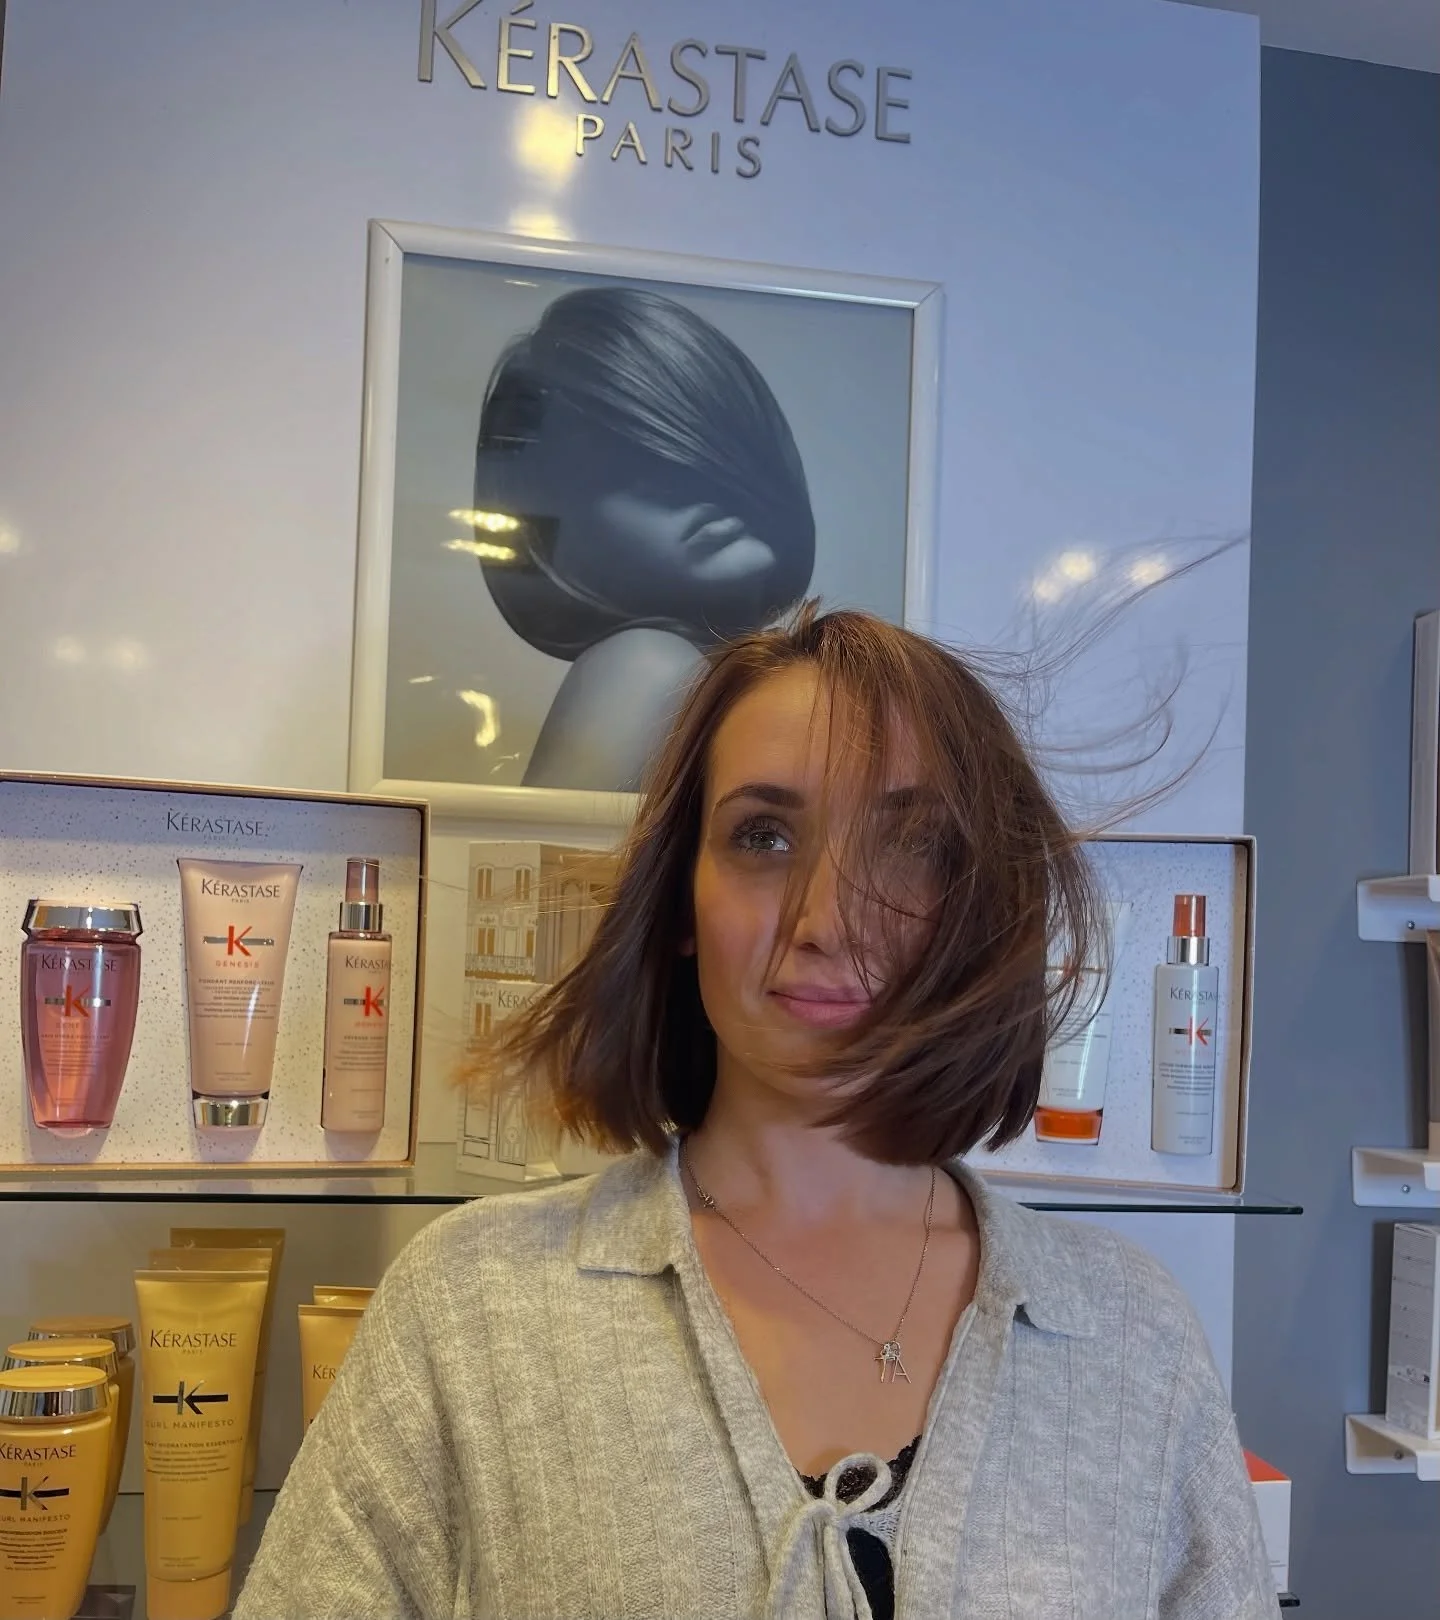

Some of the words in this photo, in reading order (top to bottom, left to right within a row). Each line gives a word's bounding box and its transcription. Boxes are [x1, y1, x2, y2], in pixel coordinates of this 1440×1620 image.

[417, 0, 913, 143] KÉRASTASE
[575, 112, 762, 178] PARIS
[167, 811, 265, 836] KÉRASTASE
[202, 878, 281, 898] KÉRASTASE
[150, 1329, 238, 1348] KÉRASTASE
[173, 1418, 235, 1429] MANIFESTO
